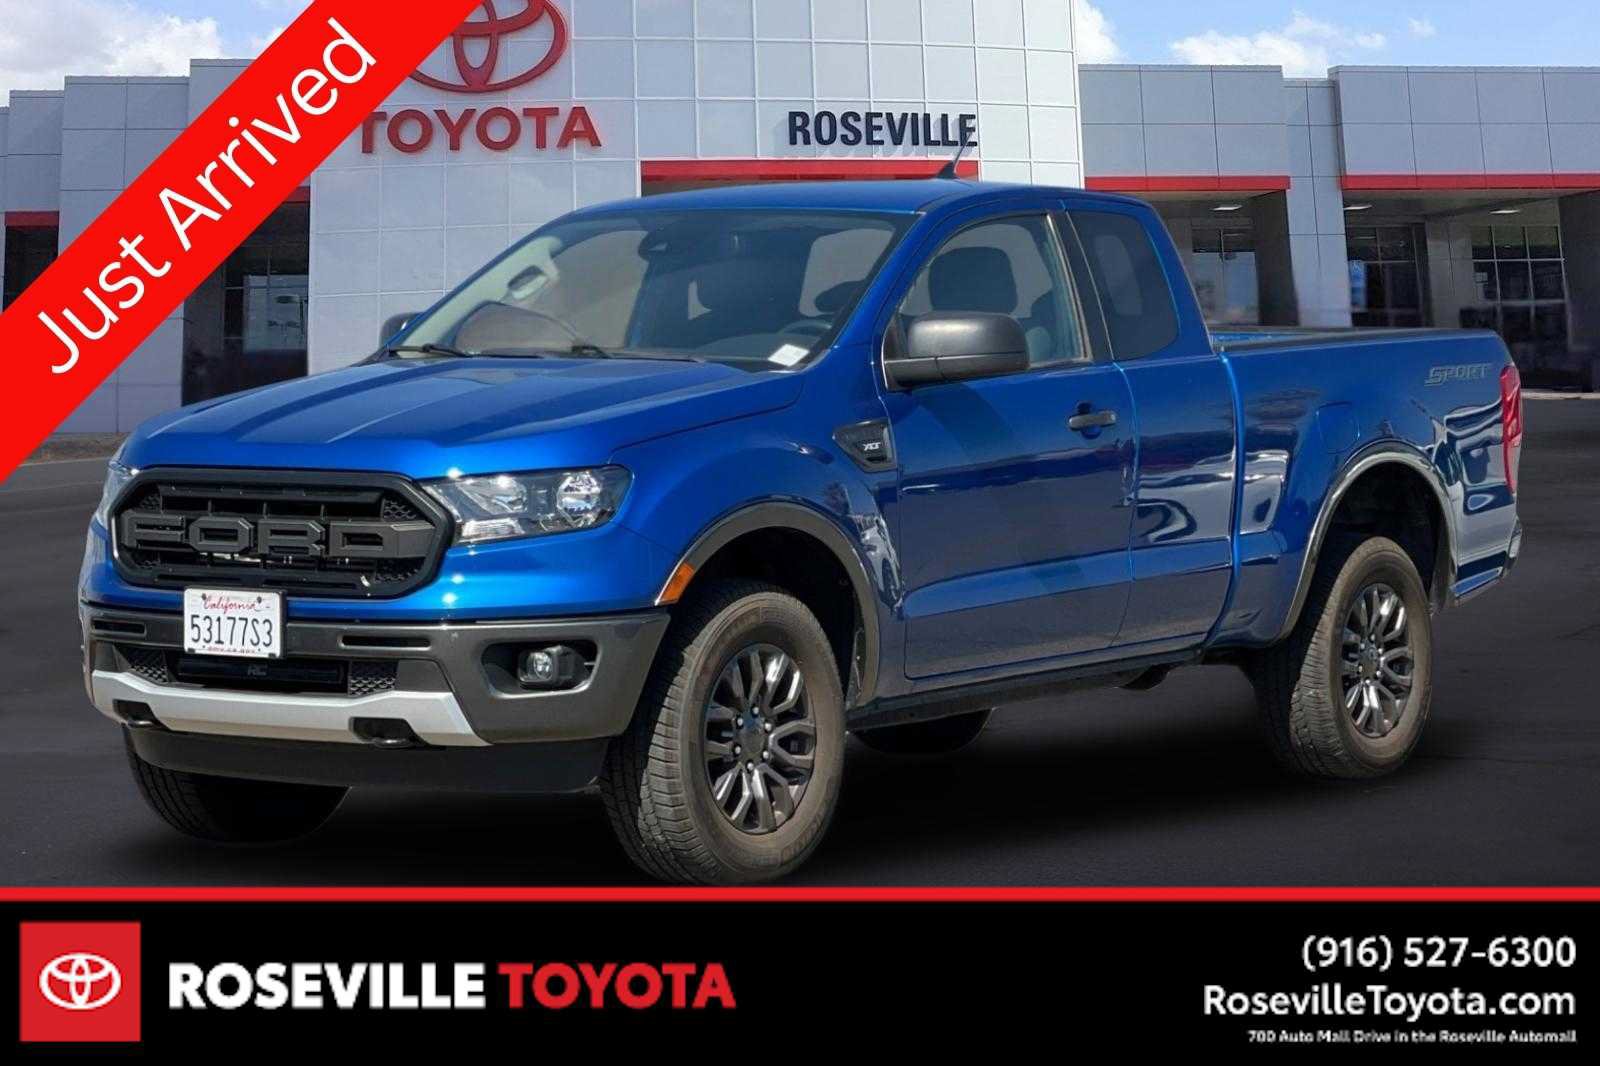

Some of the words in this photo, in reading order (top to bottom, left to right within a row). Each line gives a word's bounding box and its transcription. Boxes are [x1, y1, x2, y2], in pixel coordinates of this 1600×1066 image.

[361, 106, 602, 153] TOYOTA
[788, 111, 978, 147] ROSEVILLE
[1424, 363, 1492, 386] SPORT
[120, 512, 420, 557] FORD
[204, 594, 256, 614] California
[190, 614, 273, 648] 53177S3
